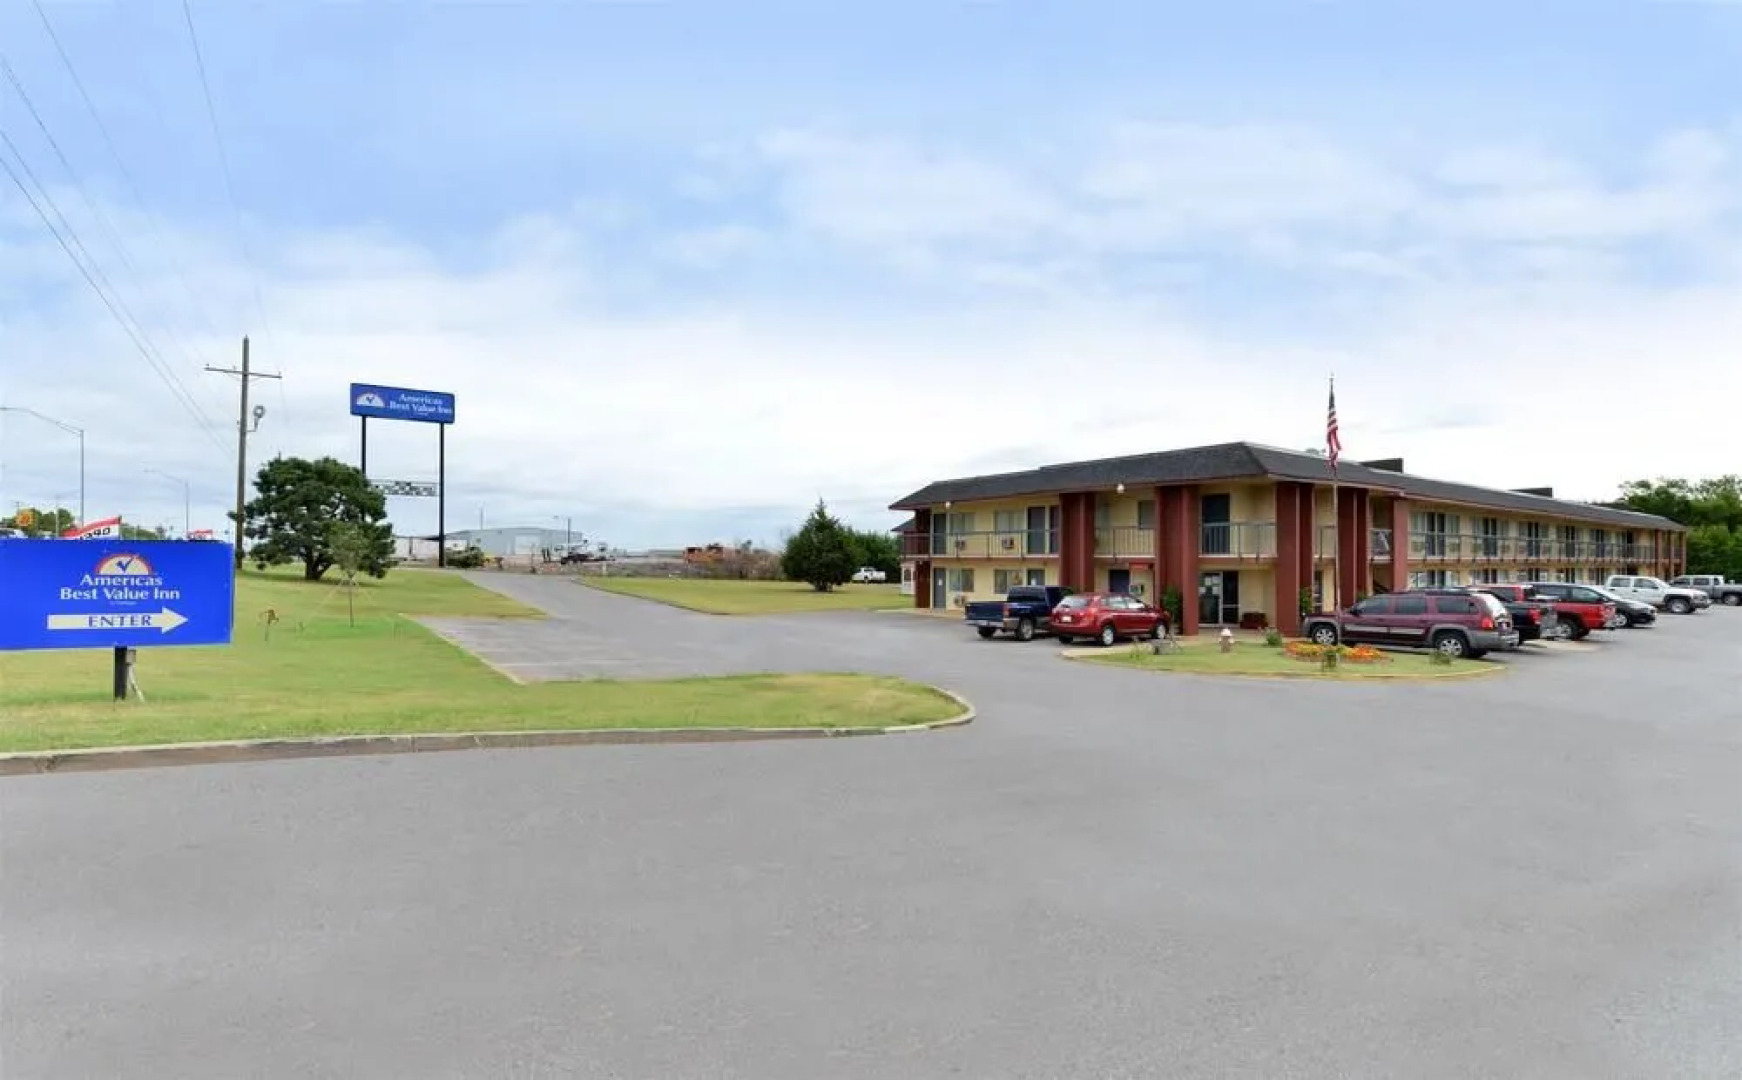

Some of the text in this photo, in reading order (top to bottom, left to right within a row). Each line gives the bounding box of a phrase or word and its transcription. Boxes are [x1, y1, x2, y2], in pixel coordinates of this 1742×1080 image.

[399, 393, 443, 405] Americas
[389, 400, 452, 413] Best Value Inn
[80, 574, 163, 586] Americas
[60, 587, 180, 600] Best Value Inn
[88, 615, 152, 627] ENTER
